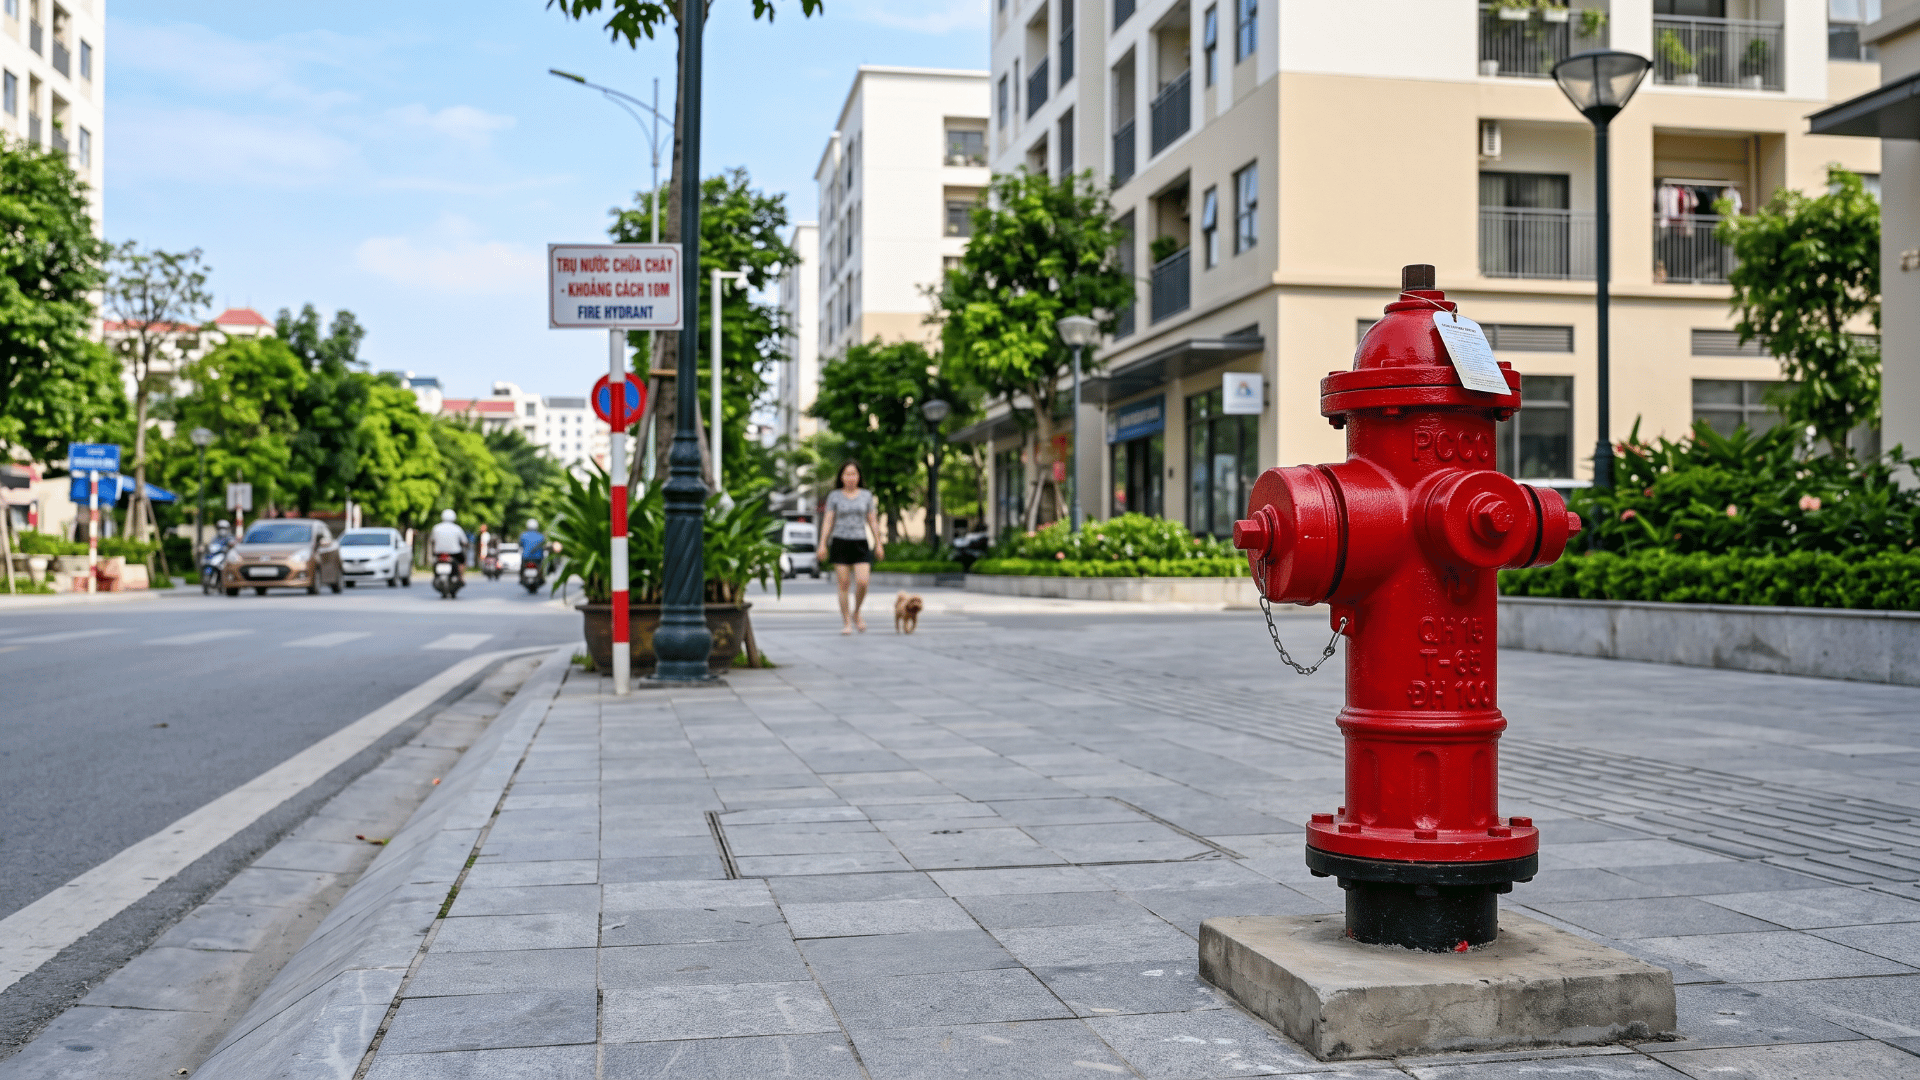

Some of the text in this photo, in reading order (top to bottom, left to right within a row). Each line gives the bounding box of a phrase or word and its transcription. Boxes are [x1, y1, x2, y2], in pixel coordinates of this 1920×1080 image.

[557, 257, 577, 276] TRỤ
[645, 254, 673, 273] CHÁY
[568, 277, 612, 297] KHOẢNG
[615, 279, 644, 297] CÁCH
[648, 282, 671, 297] 10M
[578, 305, 653, 319] FIRE HYDRANT
[1412, 429, 1489, 462] PCCC
[1417, 616, 1484, 645] QH 15
[1419, 648, 1482, 677] T-65
[1407, 680, 1490, 709] ĐH 100
